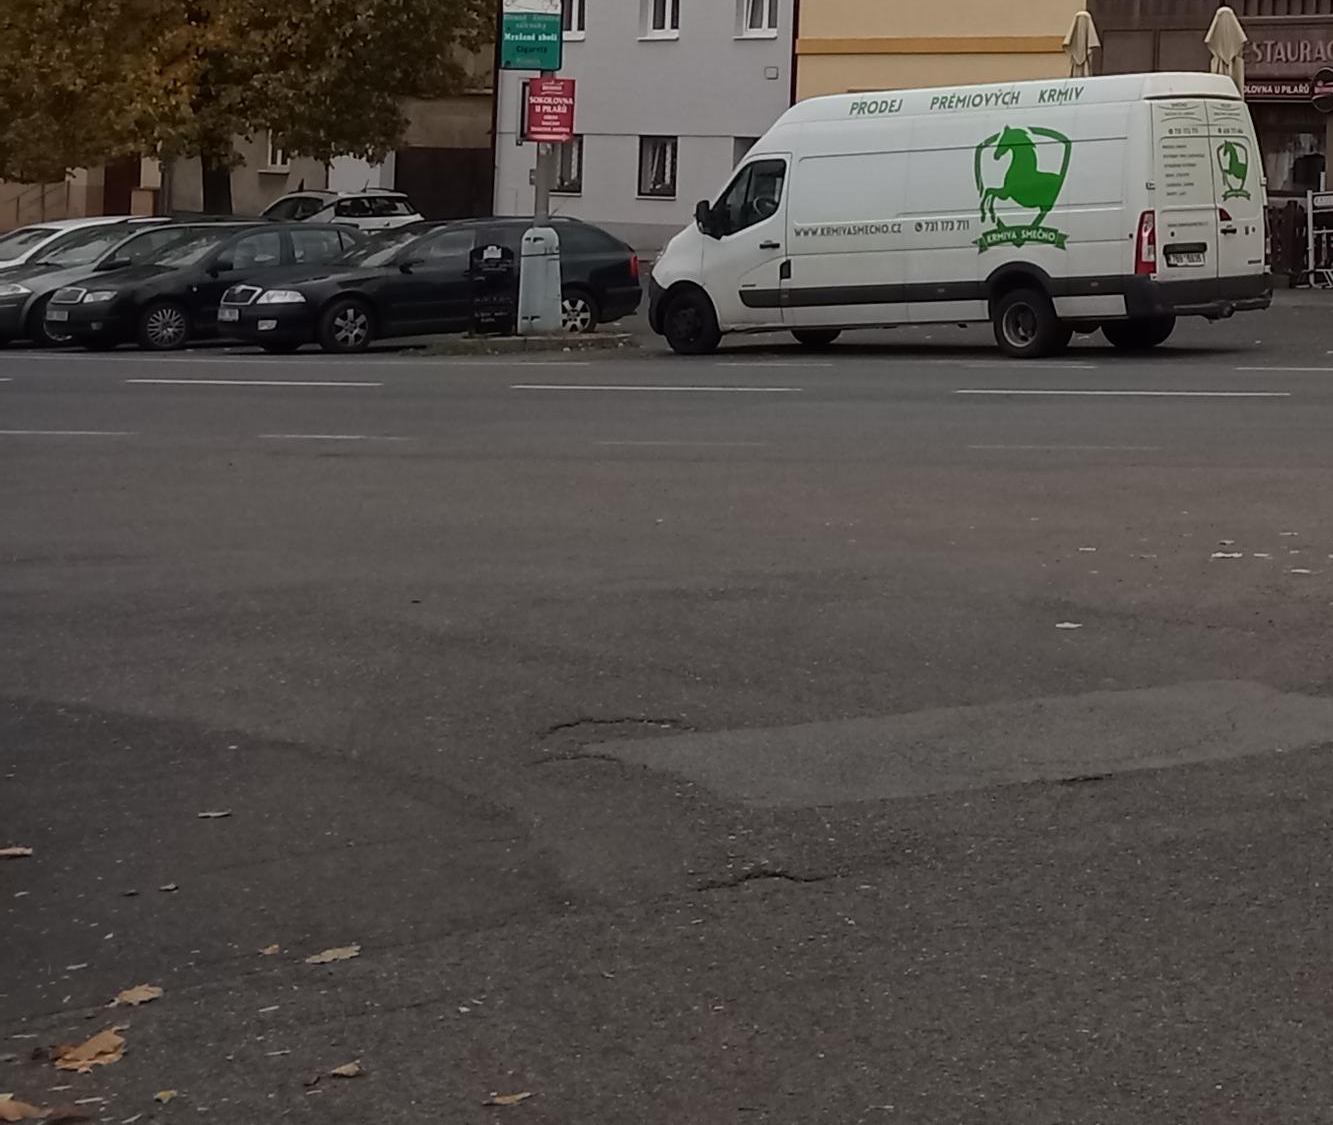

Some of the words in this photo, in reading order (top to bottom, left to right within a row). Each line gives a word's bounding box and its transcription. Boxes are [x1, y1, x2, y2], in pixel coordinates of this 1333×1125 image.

[1244, 84, 1273, 94] OLOVNA
[1274, 84, 1280, 94] U
[849, 99, 904, 116] PRODEJ
[929, 89, 1021, 111] PRÉMIOVÝCH
[1038, 86, 1084, 104] KRMIV
[987, 232, 1017, 243] KRMIVA
[1021, 228, 1056, 242] SMEČNO
